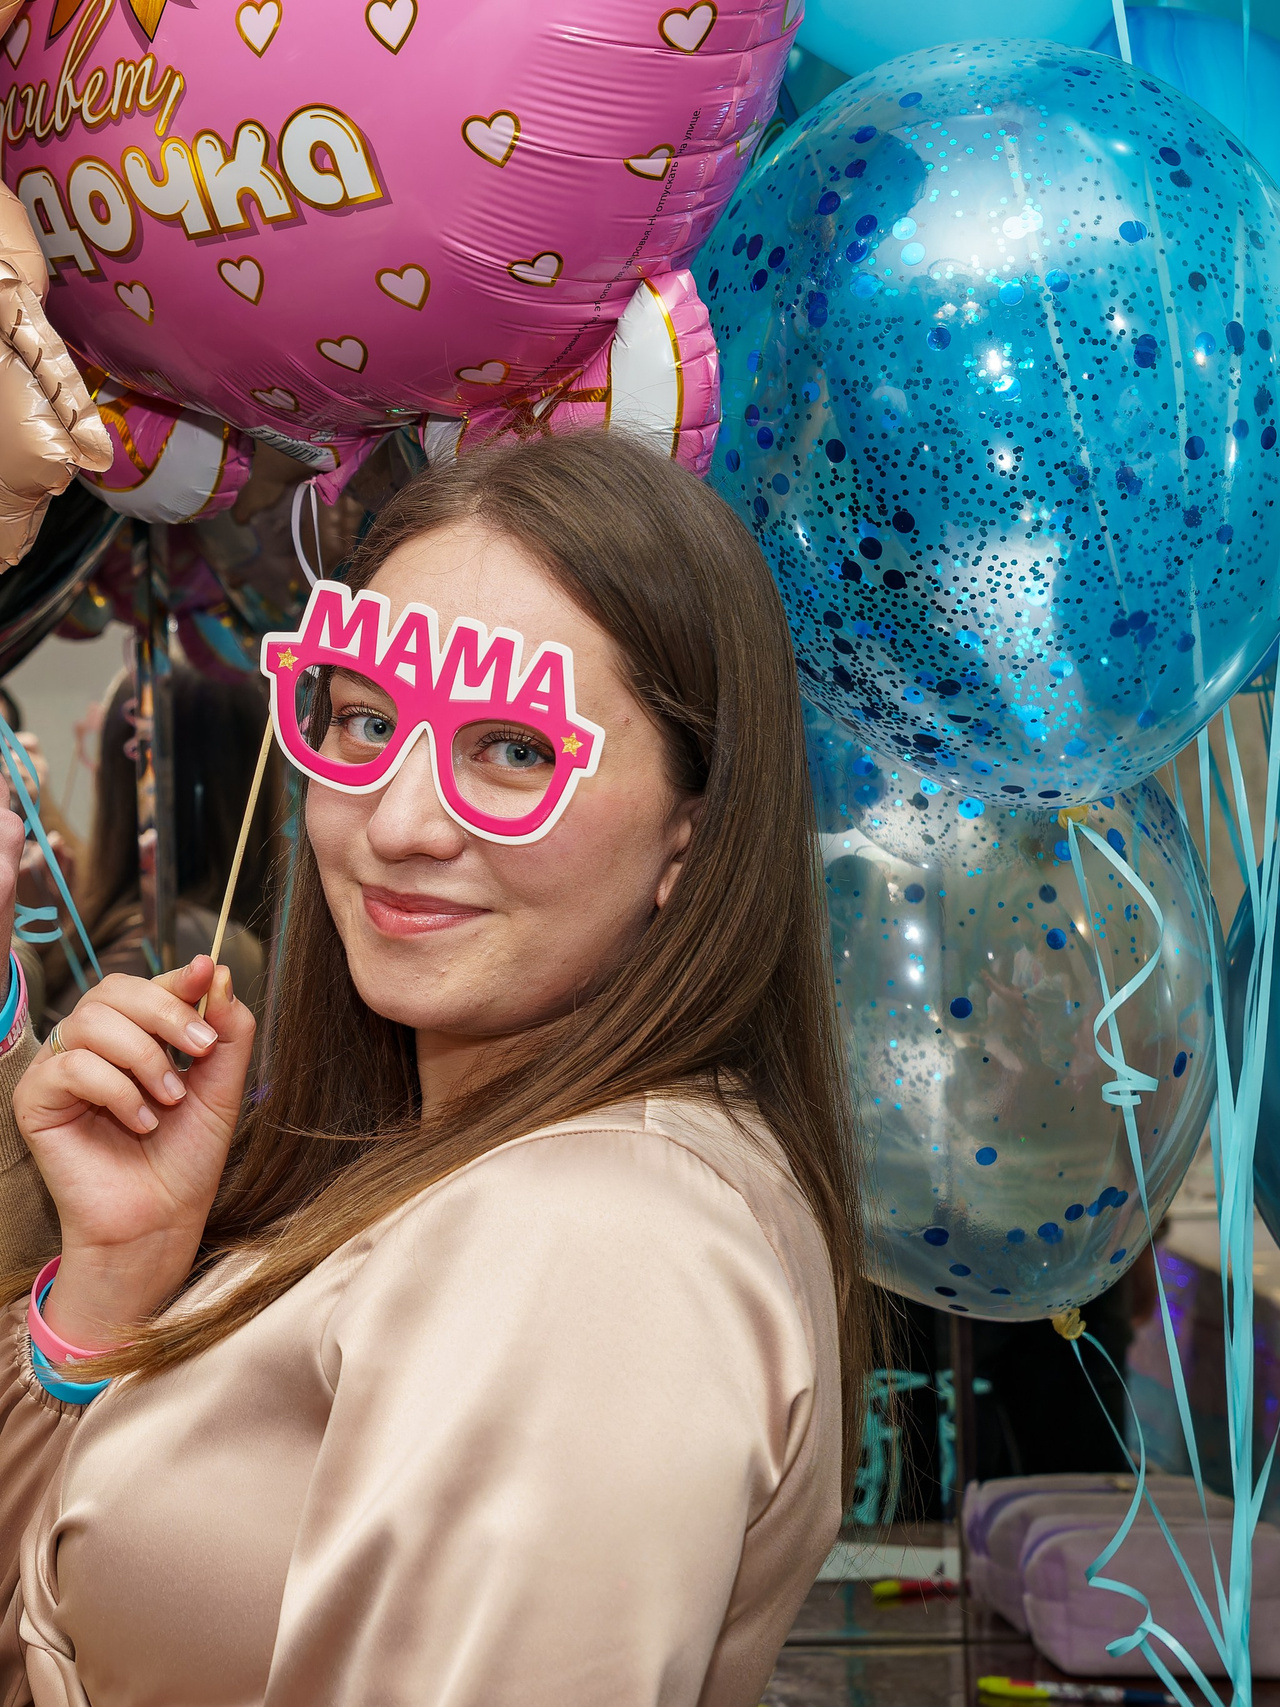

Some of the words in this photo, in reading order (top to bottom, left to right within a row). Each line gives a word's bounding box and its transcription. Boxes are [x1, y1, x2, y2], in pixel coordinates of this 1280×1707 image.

[655, 160, 679, 213] отпускать
[683, 107, 702, 141] улице.
[299, 588, 568, 720] МАМА
